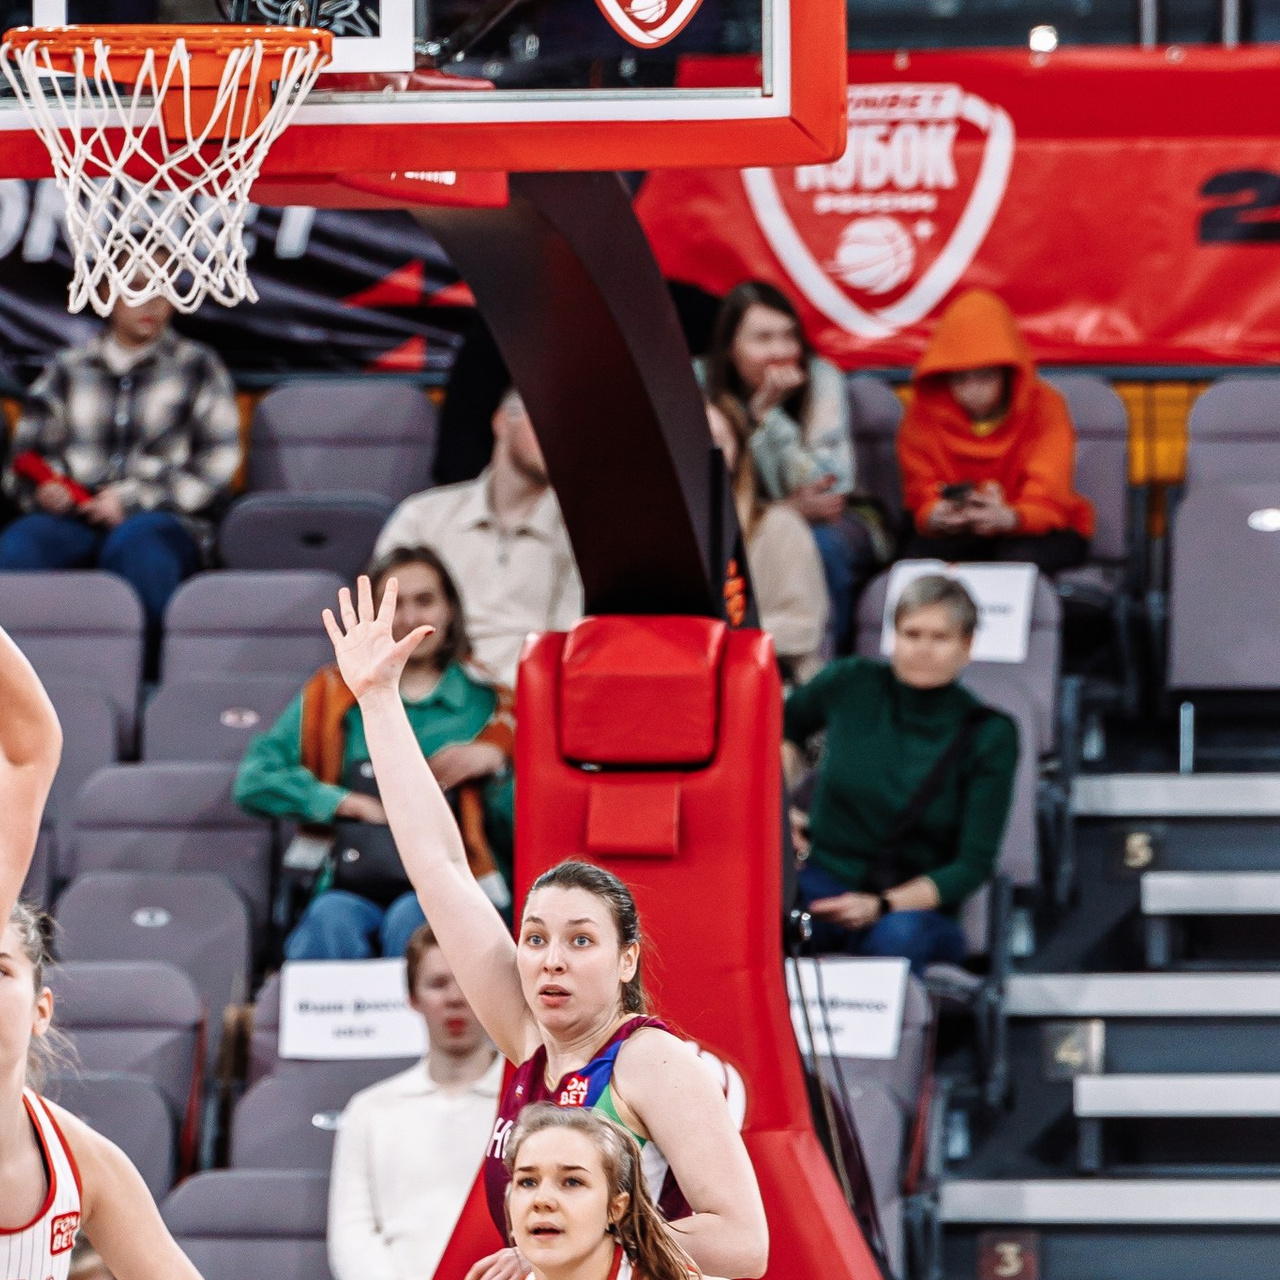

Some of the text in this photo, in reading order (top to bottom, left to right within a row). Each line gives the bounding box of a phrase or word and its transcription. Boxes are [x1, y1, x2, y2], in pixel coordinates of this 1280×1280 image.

[567, 1077, 589, 1091] ON
[559, 1091, 588, 1106] BET
[994, 1241, 1023, 1278] 3
